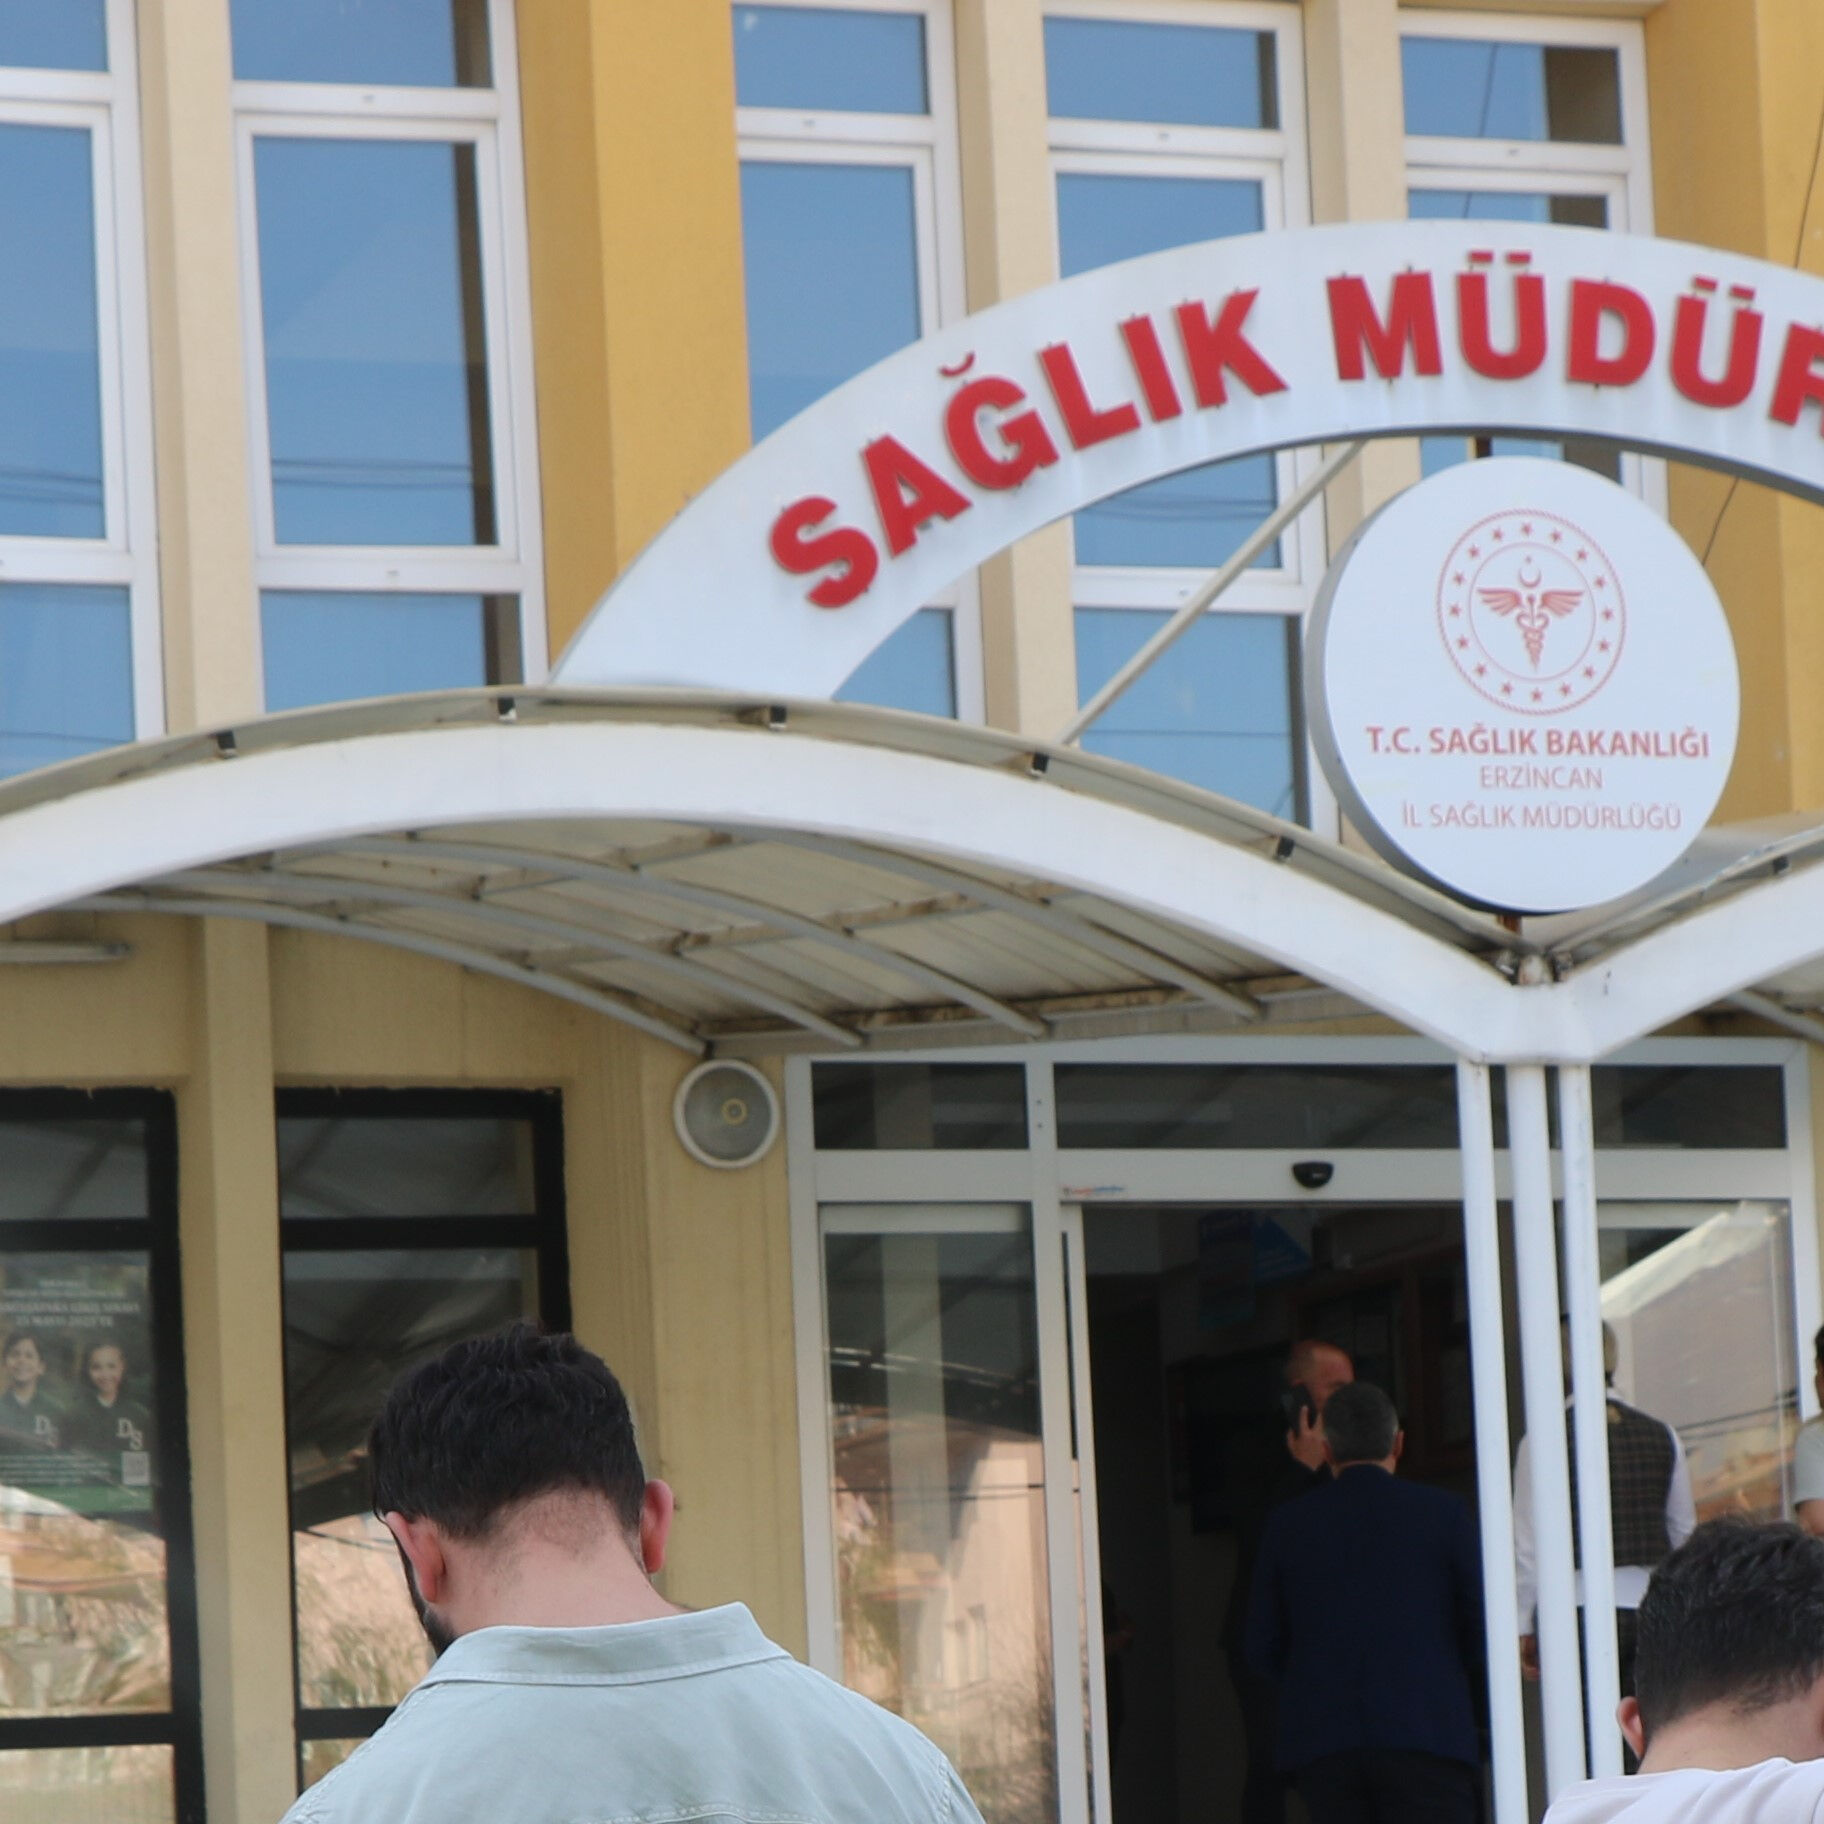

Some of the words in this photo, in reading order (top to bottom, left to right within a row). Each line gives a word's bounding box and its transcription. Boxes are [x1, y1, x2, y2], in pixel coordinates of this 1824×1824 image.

[769, 286, 1288, 608] SAĞLIK
[1366, 726, 1421, 754] T.C.
[1429, 722, 1536, 755] SAĞLIK
[1546, 726, 1710, 759] BAKANLIĞI
[1479, 763, 1603, 790] ERZİNCAN
[1402, 800, 1422, 827] İL
[1430, 800, 1516, 829] SAĞLIK
[1523, 801, 1682, 831] MÜDÜRLÜĞÜ
